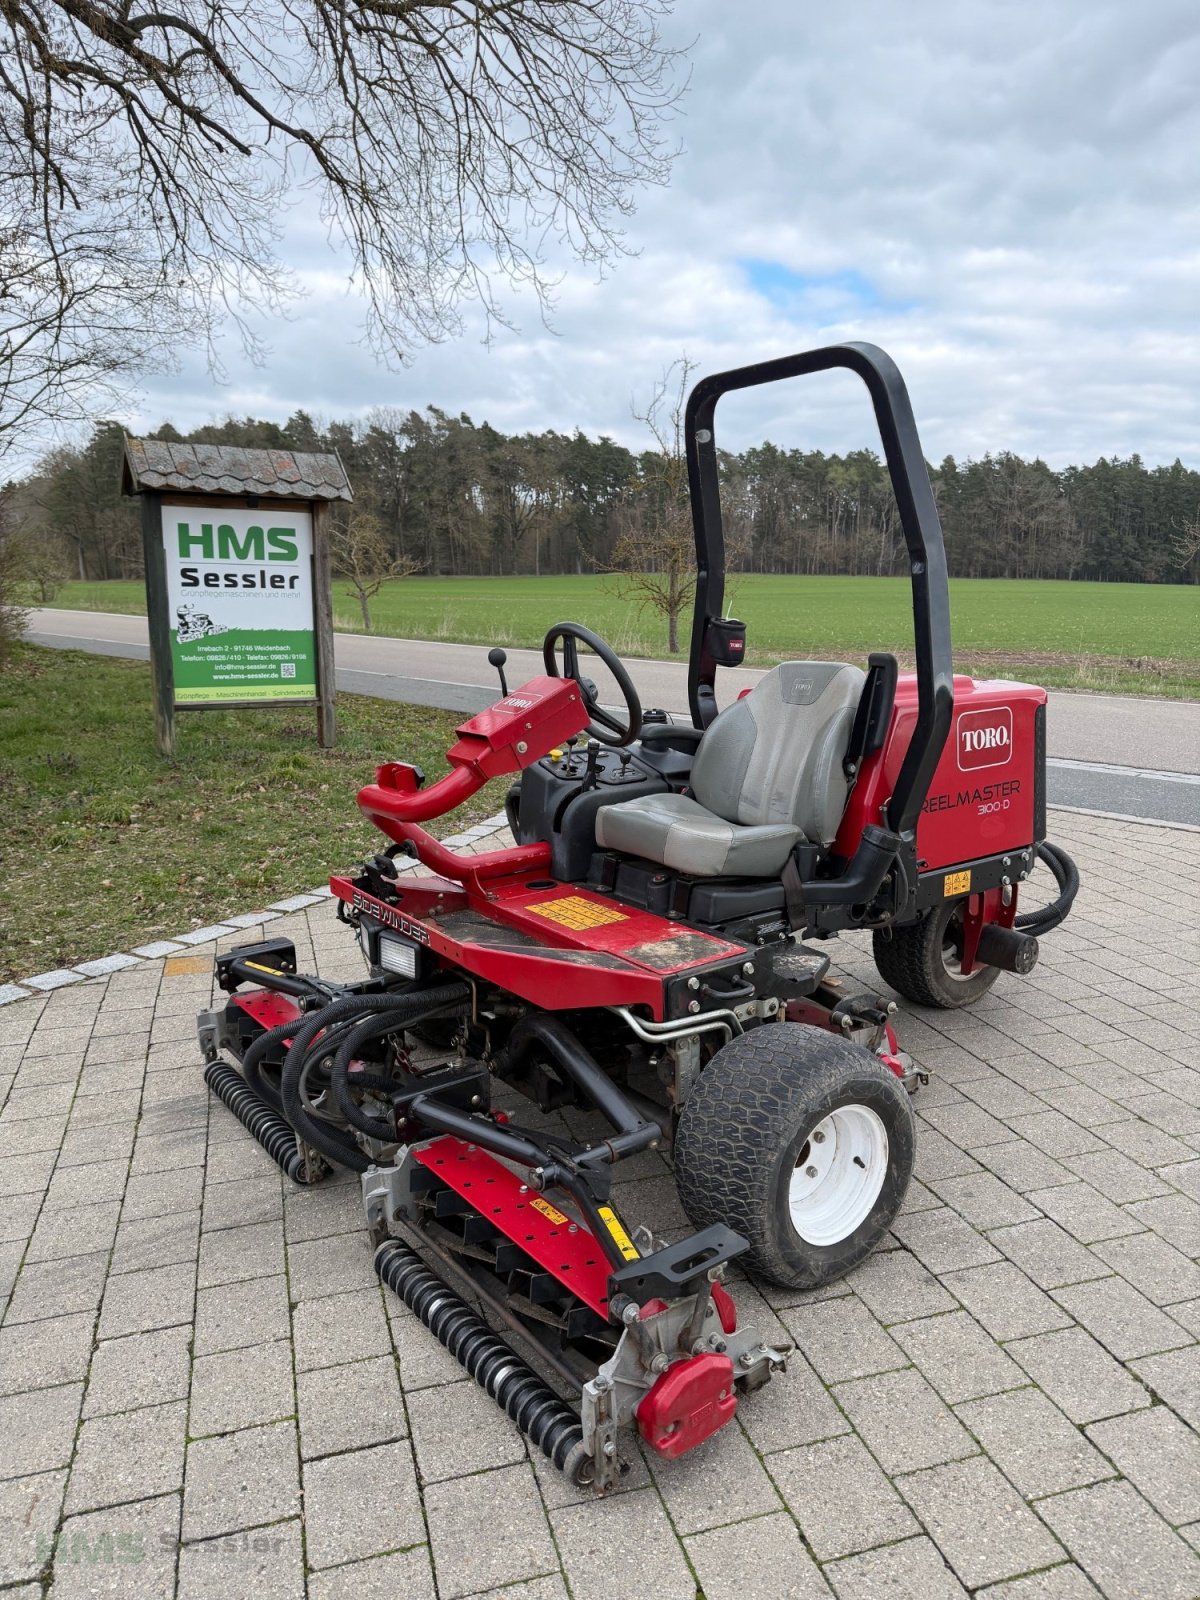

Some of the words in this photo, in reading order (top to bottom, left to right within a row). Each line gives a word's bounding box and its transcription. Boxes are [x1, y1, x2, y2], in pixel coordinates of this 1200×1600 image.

[177, 523, 298, 561] HMS
[180, 568, 299, 589] Sessler
[266, 590, 279, 598] und
[503, 697, 532, 708] TORO
[962, 725, 1008, 752] TORO
[920, 779, 1021, 813] REELMASTER
[352, 891, 432, 947] SIDEWINDER
